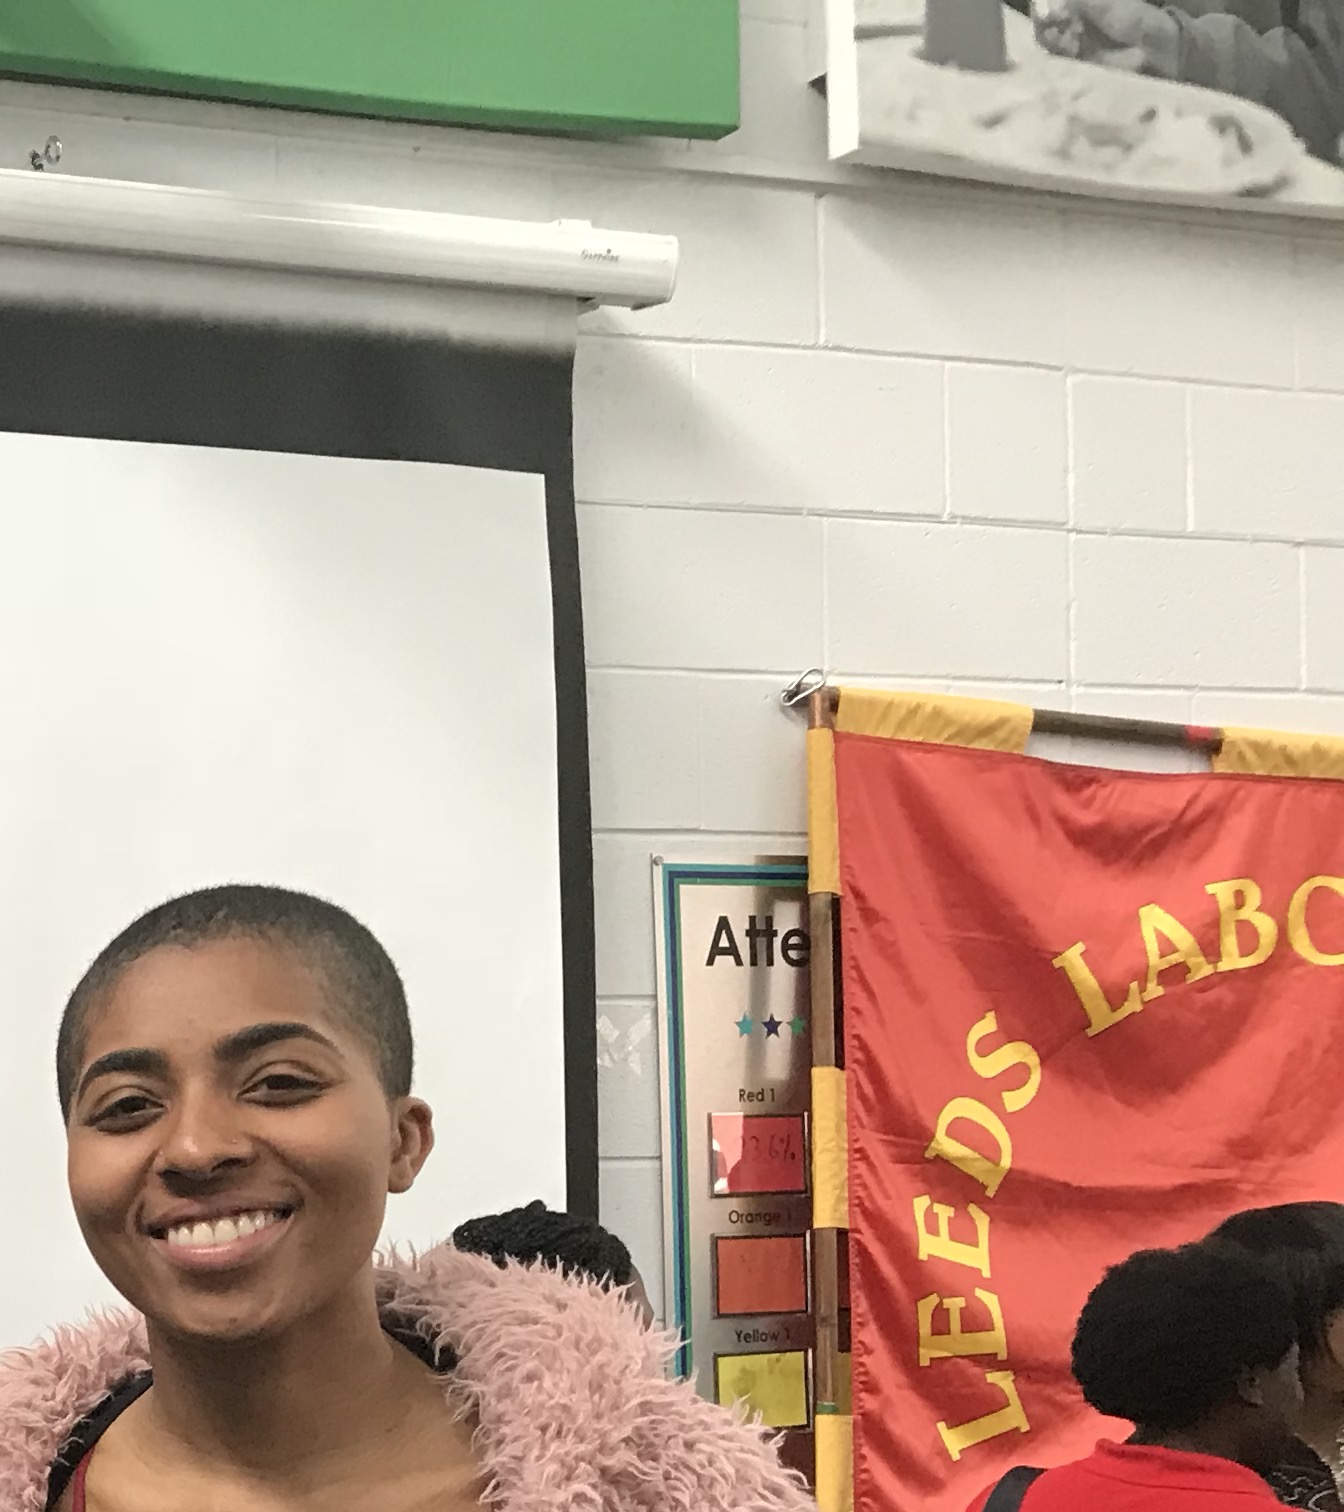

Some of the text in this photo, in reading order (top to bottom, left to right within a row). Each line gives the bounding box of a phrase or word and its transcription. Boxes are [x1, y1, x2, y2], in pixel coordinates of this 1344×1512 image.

[738, 1088, 776, 1103] Red 1
[728, 1209, 781, 1226] Orange
[917, 1010, 1043, 1462] LEEDS
[734, 1328, 782, 1344] Yellow
